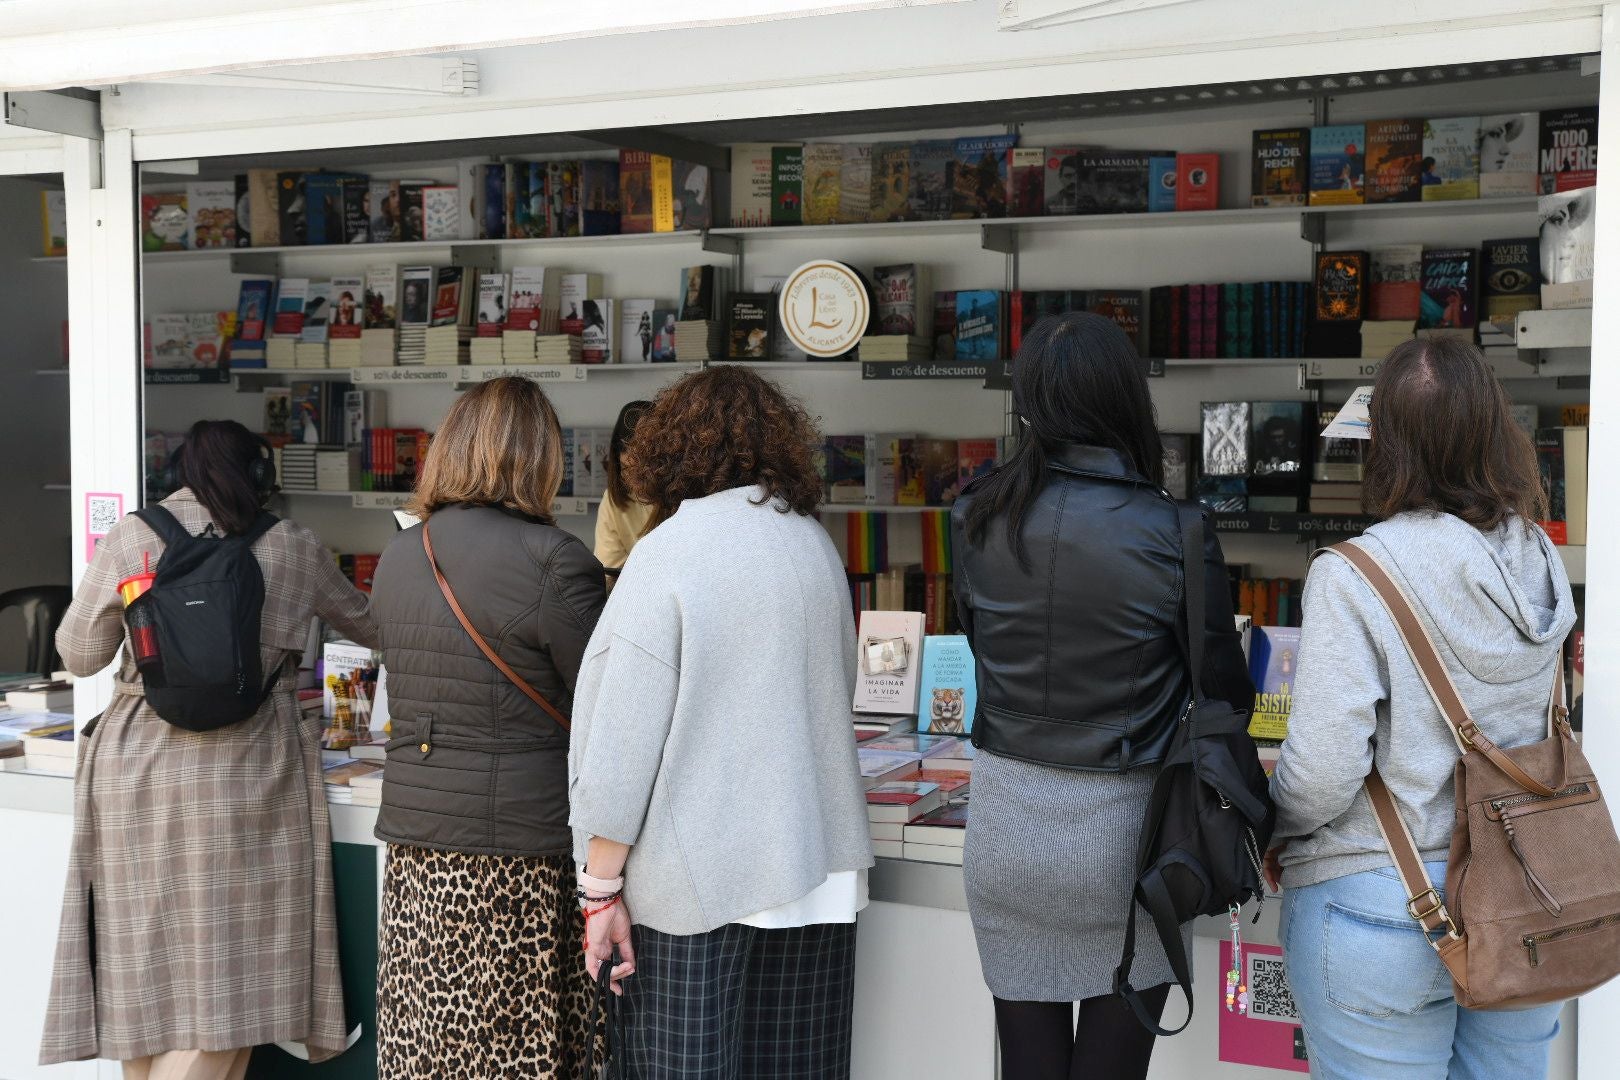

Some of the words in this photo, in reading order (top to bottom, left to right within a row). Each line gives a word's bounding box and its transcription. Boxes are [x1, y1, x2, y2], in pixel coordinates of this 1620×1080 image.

[1378, 124, 1410, 133] ARTURO
[1552, 128, 1588, 147] TODO
[958, 138, 1014, 151] GLADIADORES
[858, 147, 872, 157] VR
[1258, 148, 1280, 158] HIJO
[1282, 147, 1301, 157] DEL
[1083, 158, 1096, 168] LA
[1098, 157, 1140, 168] ARMADA
[1264, 159, 1295, 169] REICH
[1541, 145, 1598, 172] MUERE
[778, 164, 803, 172] INFOG
[778, 174, 803, 182] RECON
[1492, 245, 1529, 256] JAVIER
[1492, 255, 1530, 265] SIERRA
[819, 269, 841, 282] desde
[1110, 297, 1139, 306] CORTE
[1111, 315, 1139, 324] AMAS
[807, 335, 846, 346] ALICANTE
[373, 370, 391, 380] 10%
[392, 369, 402, 380] de
[401, 368, 448, 380] descuento
[482, 369, 499, 380] 10%
[500, 368, 511, 379] de
[512, 367, 562, 379] descuento
[890, 366, 912, 376] 10%
[914, 364, 927, 376] de
[928, 364, 986, 376] descuento
[376, 497, 392, 506] 10%
[1297, 519, 1323, 530] 10%
[1325, 518, 1341, 531] de
[865, 679, 905, 687] IMAGINAR
[882, 688, 901, 696] VIDA
[1254, 693, 1292, 713] ASISTE
